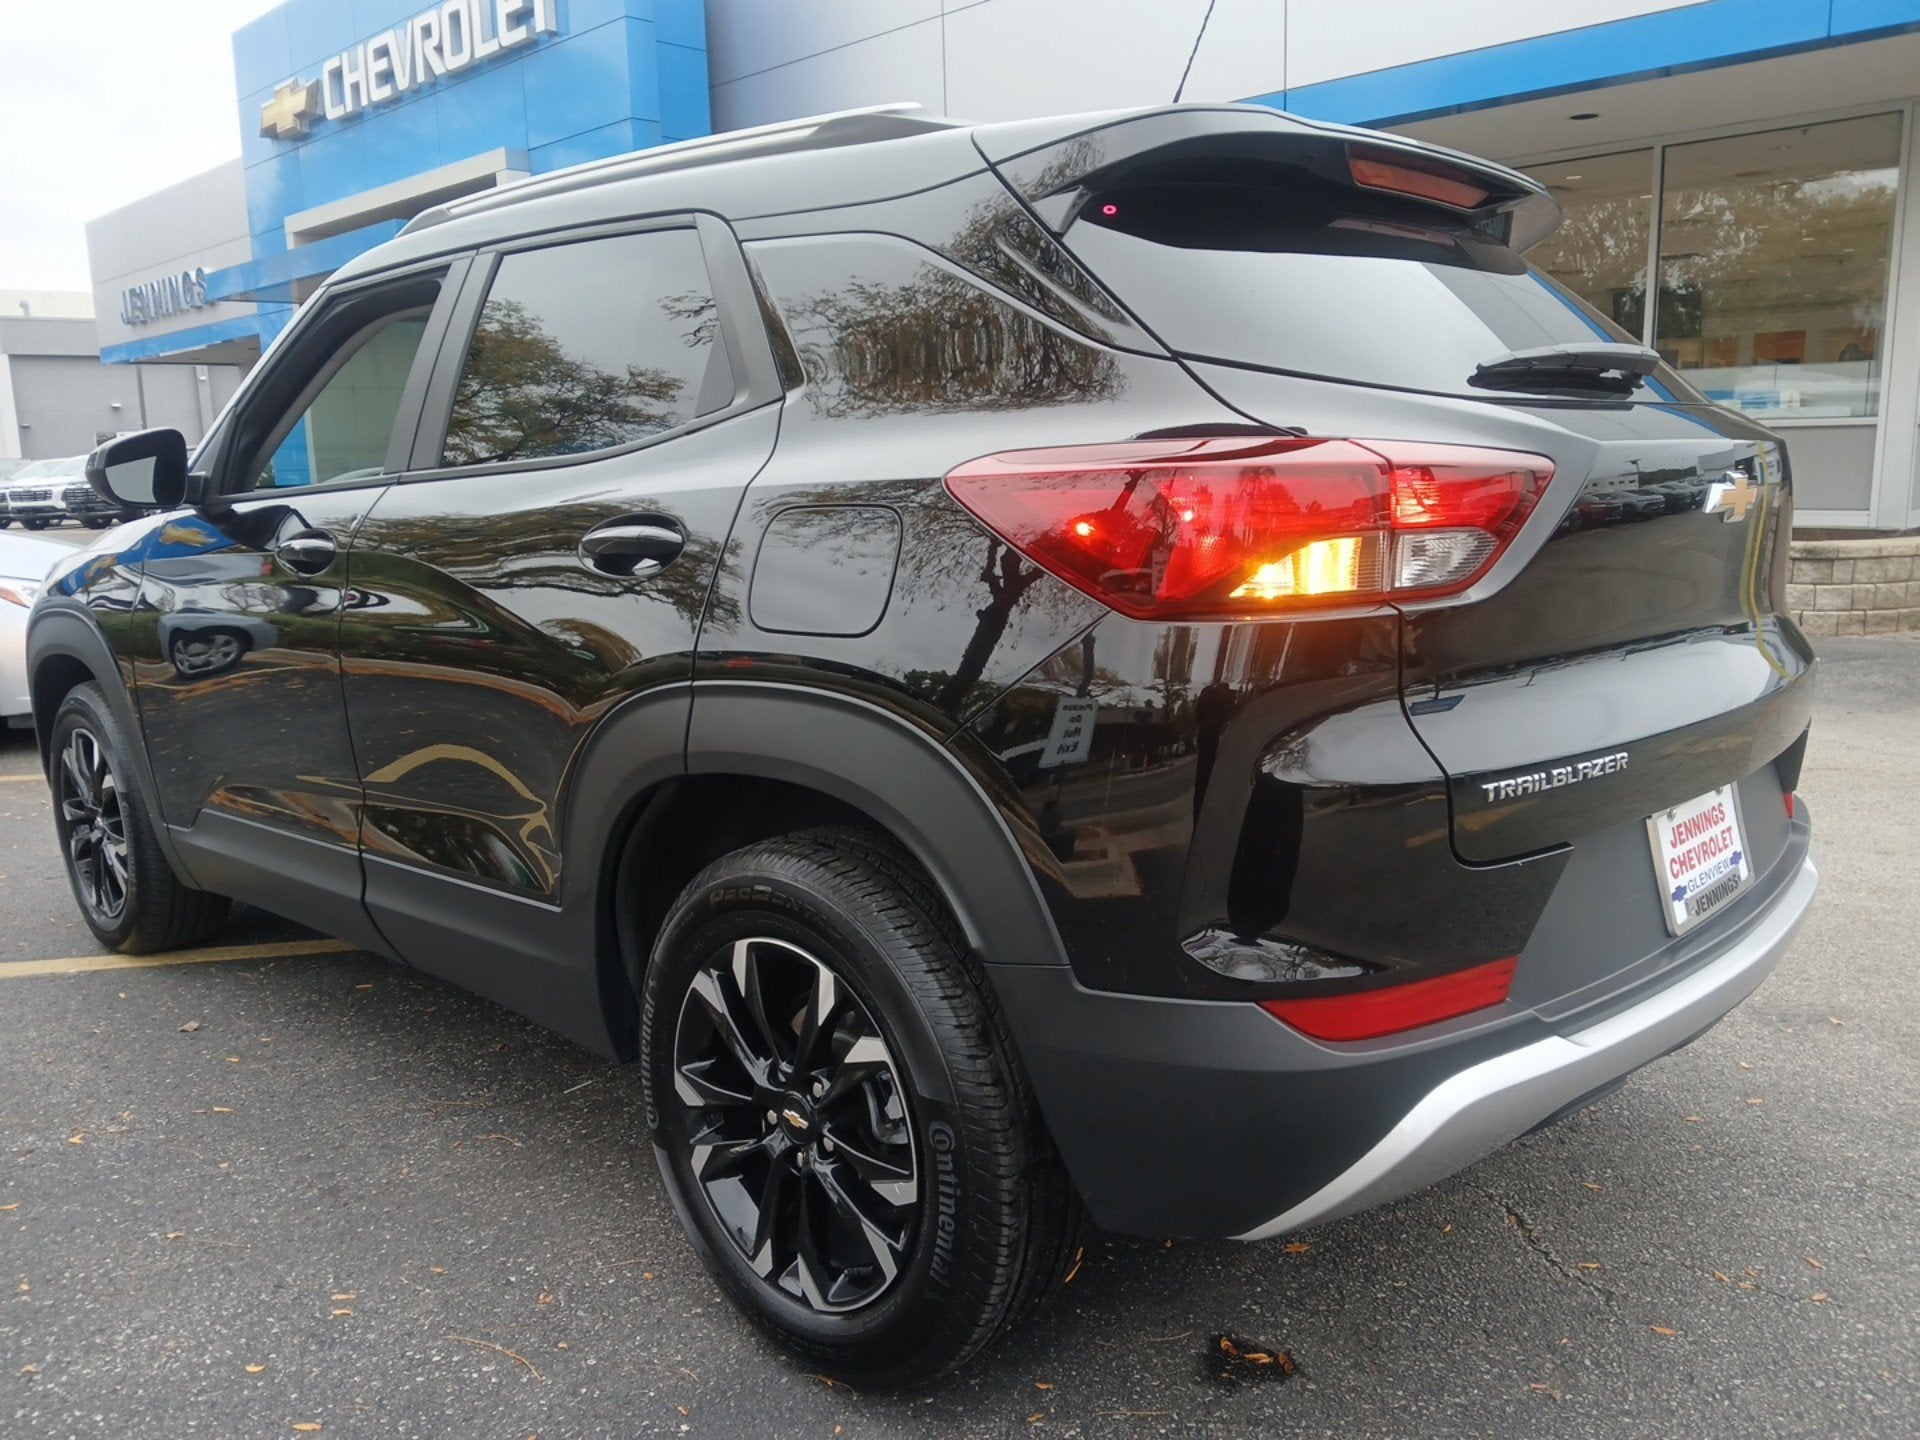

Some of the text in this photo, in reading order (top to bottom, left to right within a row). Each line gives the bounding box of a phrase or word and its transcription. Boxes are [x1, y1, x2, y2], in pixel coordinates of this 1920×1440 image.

[120, 267, 207, 325] JENNINGS
[1481, 751, 1629, 803] TRAILBLAZER
[1670, 802, 1726, 849] JENNINGS
[1669, 826, 1735, 880] CHEVROLET
[1687, 856, 1733, 892] GLENVIEW
[1695, 874, 1740, 917] JENNINGS
[640, 992, 660, 1130] Continental
[928, 1120, 961, 1288] Continental
